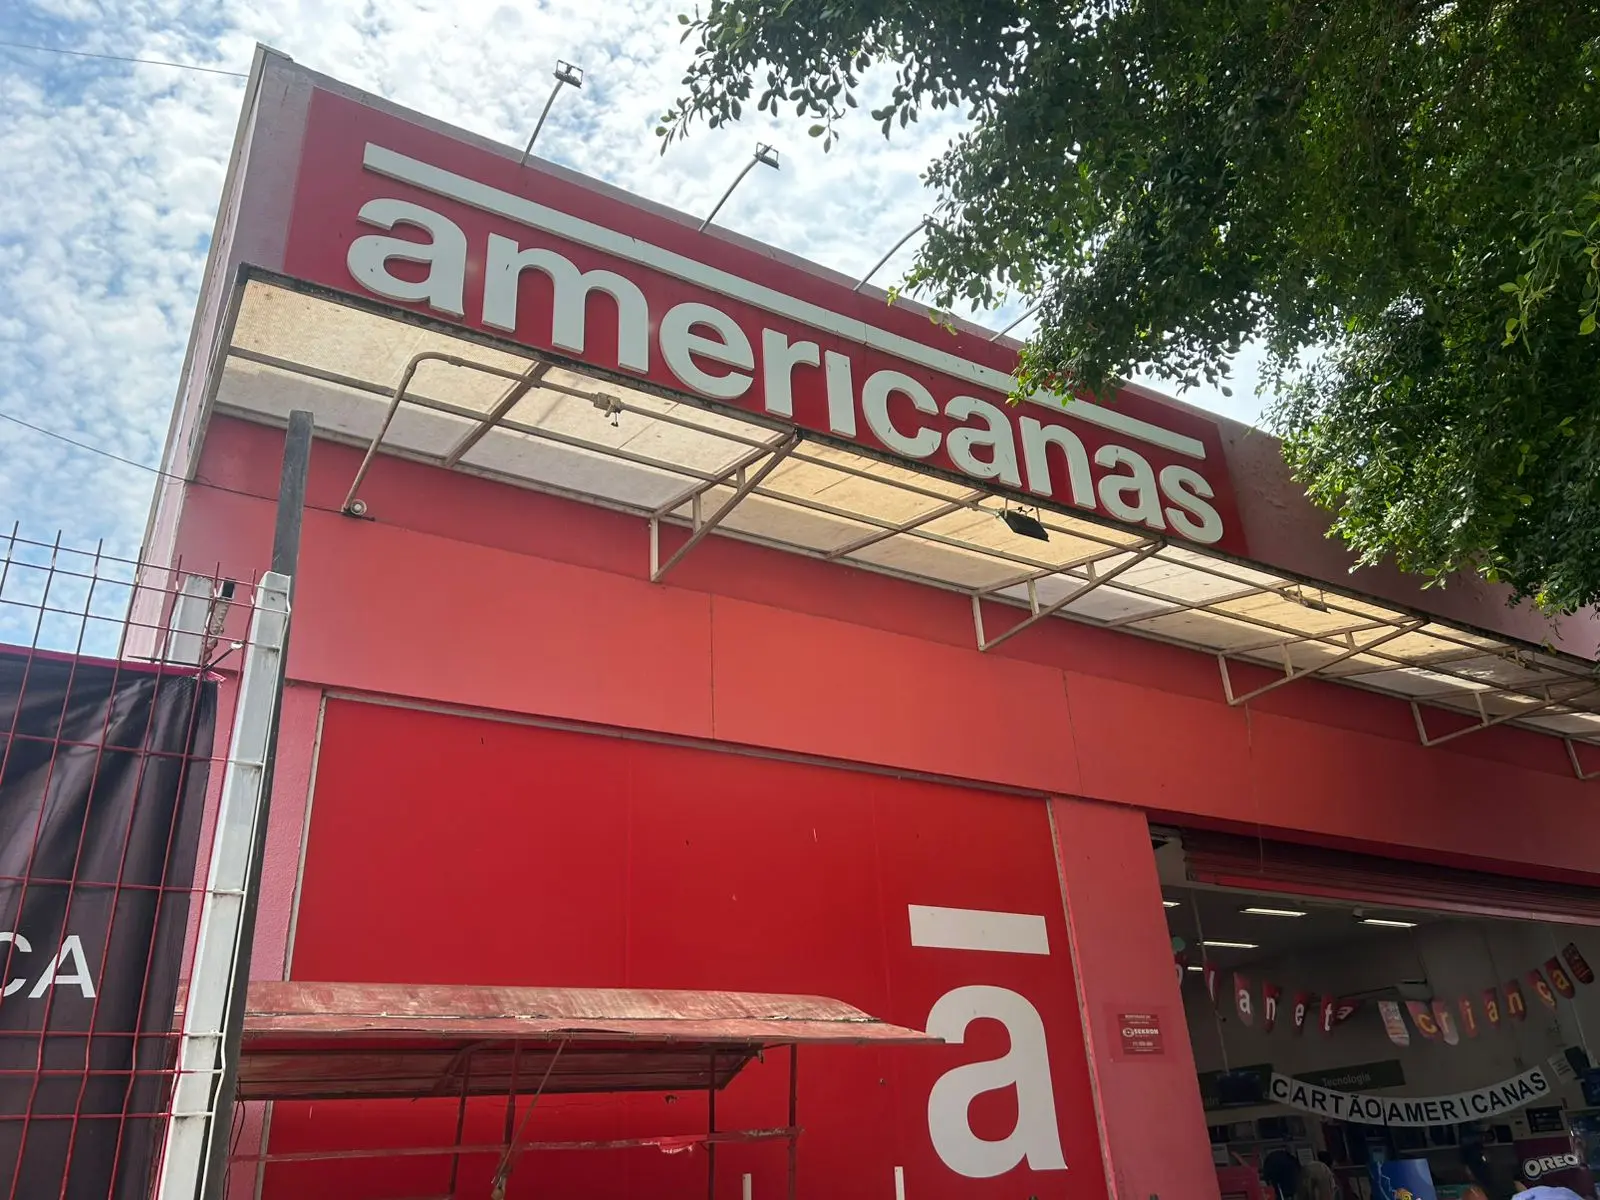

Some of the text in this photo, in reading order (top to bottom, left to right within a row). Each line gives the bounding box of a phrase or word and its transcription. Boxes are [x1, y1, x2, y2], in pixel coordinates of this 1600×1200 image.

[347, 198, 1224, 545] americanas
[1416, 968, 1568, 1034] criança
[1272, 1072, 1547, 1123] CARTÃO AMERICANAS
[1321, 1072, 1372, 1088] Tecnologia
[1524, 1154, 1579, 1178] OREO
